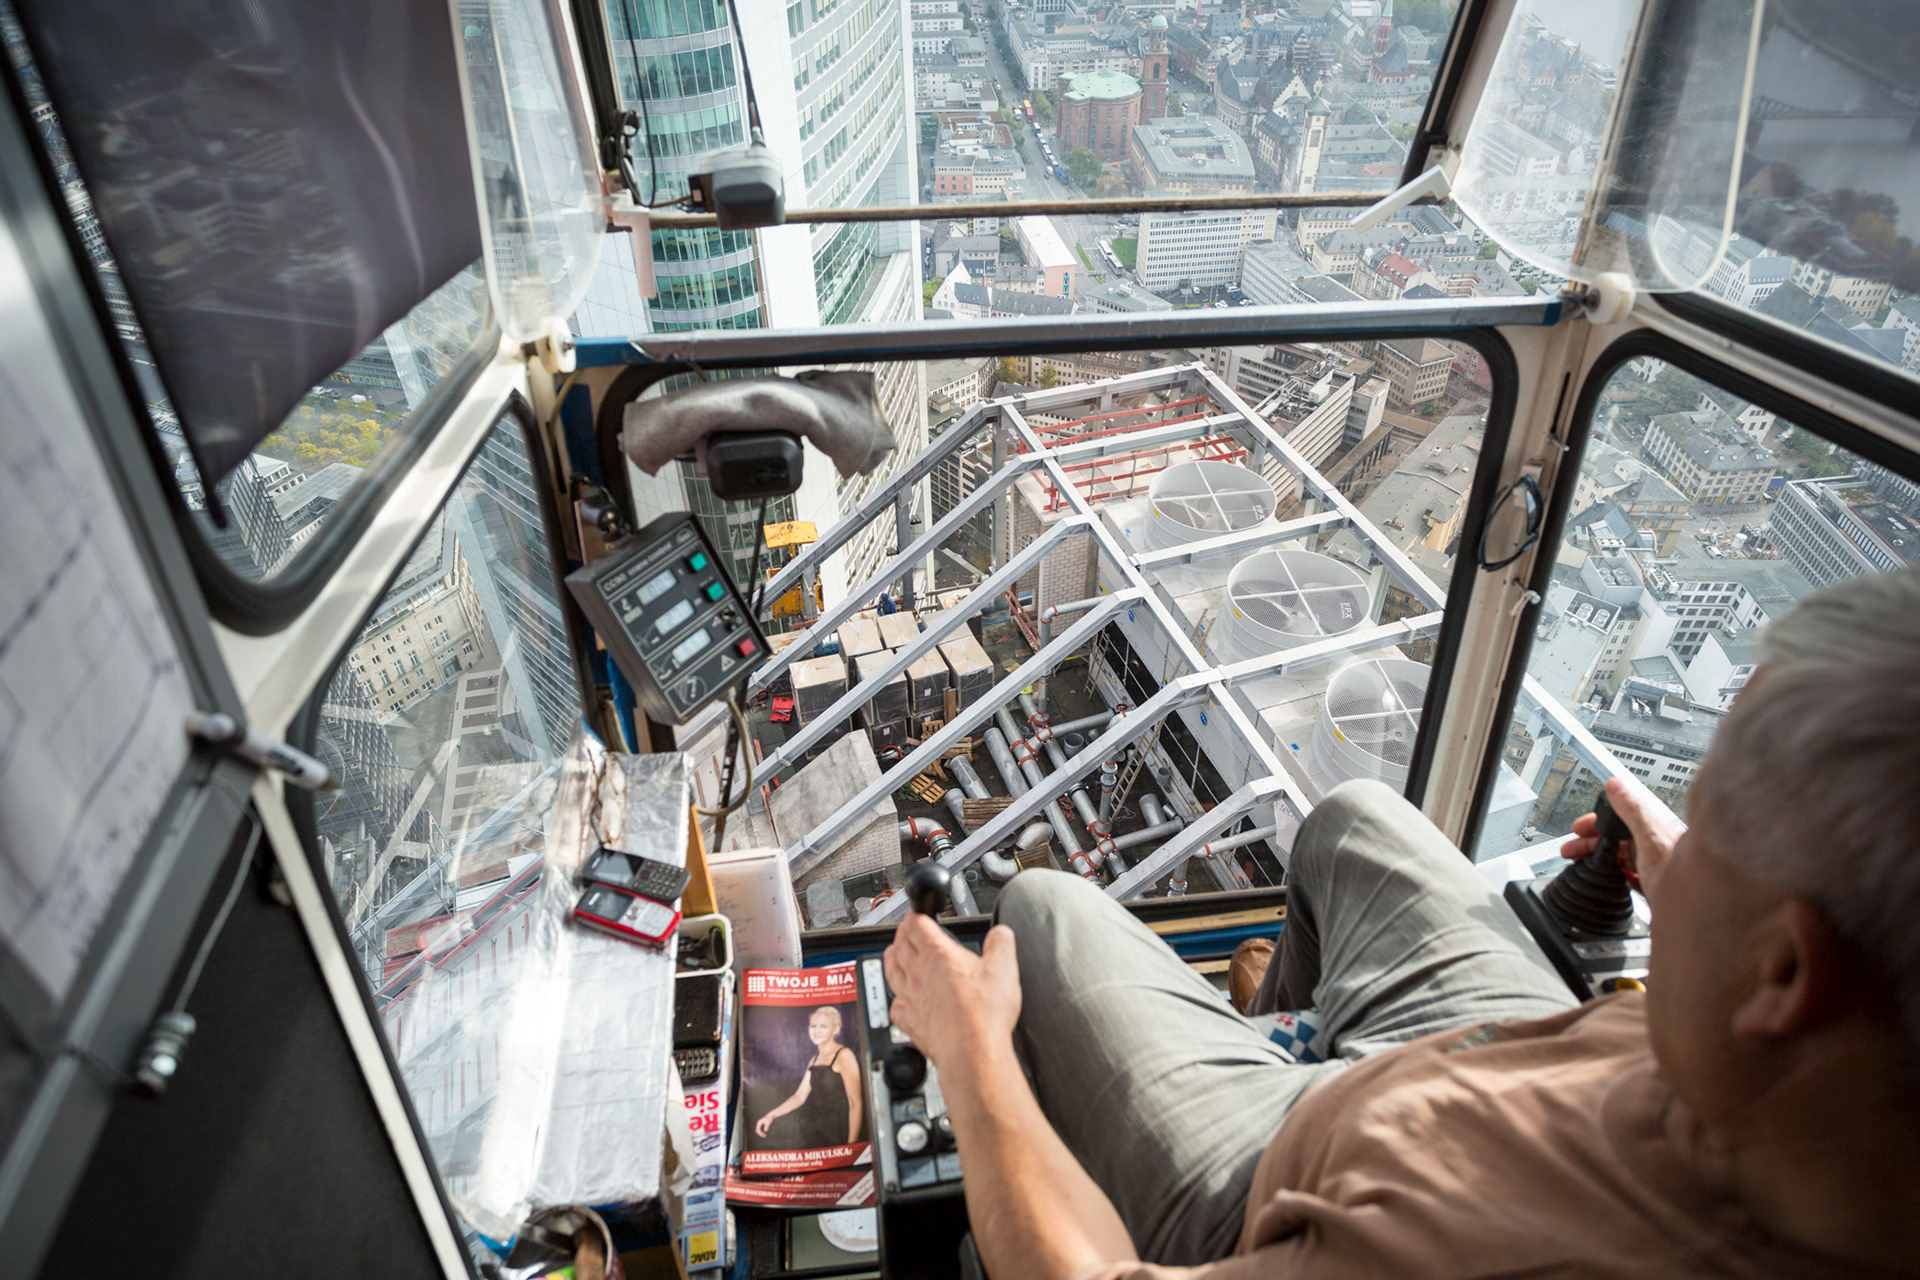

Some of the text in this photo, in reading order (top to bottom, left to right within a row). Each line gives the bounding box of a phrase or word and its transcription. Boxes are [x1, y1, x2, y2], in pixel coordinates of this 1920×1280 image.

[767, 975, 819, 988] TWOJE
[684, 1091, 719, 1114] Sie
[745, 1152, 803, 1164] ALEKSANDRA
[690, 1249, 717, 1264] ADAC
